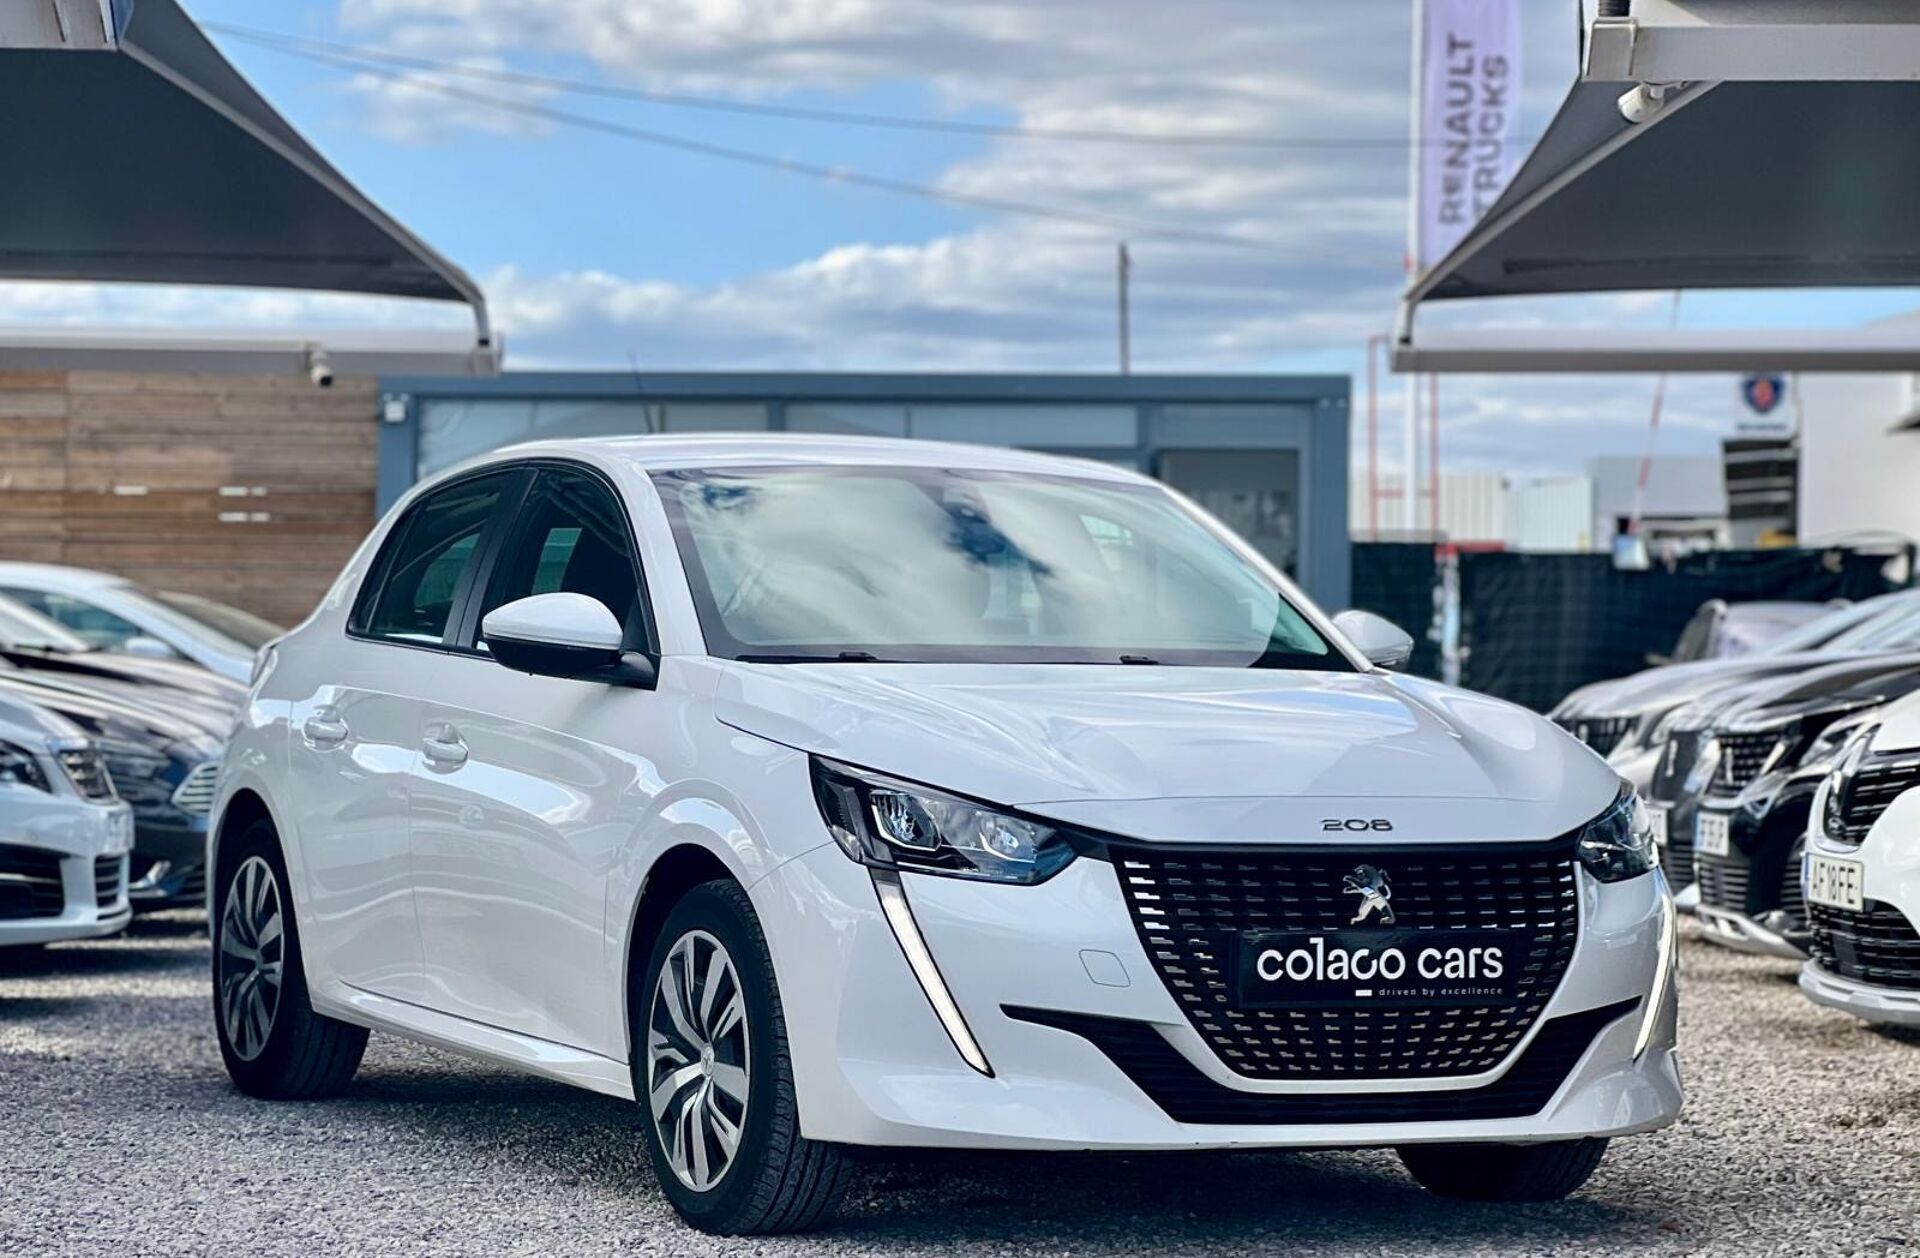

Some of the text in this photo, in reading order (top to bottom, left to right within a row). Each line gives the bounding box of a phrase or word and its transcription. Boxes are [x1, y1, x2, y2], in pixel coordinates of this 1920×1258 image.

[1438, 32, 1476, 226] RENAULT
[1320, 818, 1393, 832] 208
[1417, 947, 1504, 980] cars
[1378, 986, 1504, 998] driven by excellence
